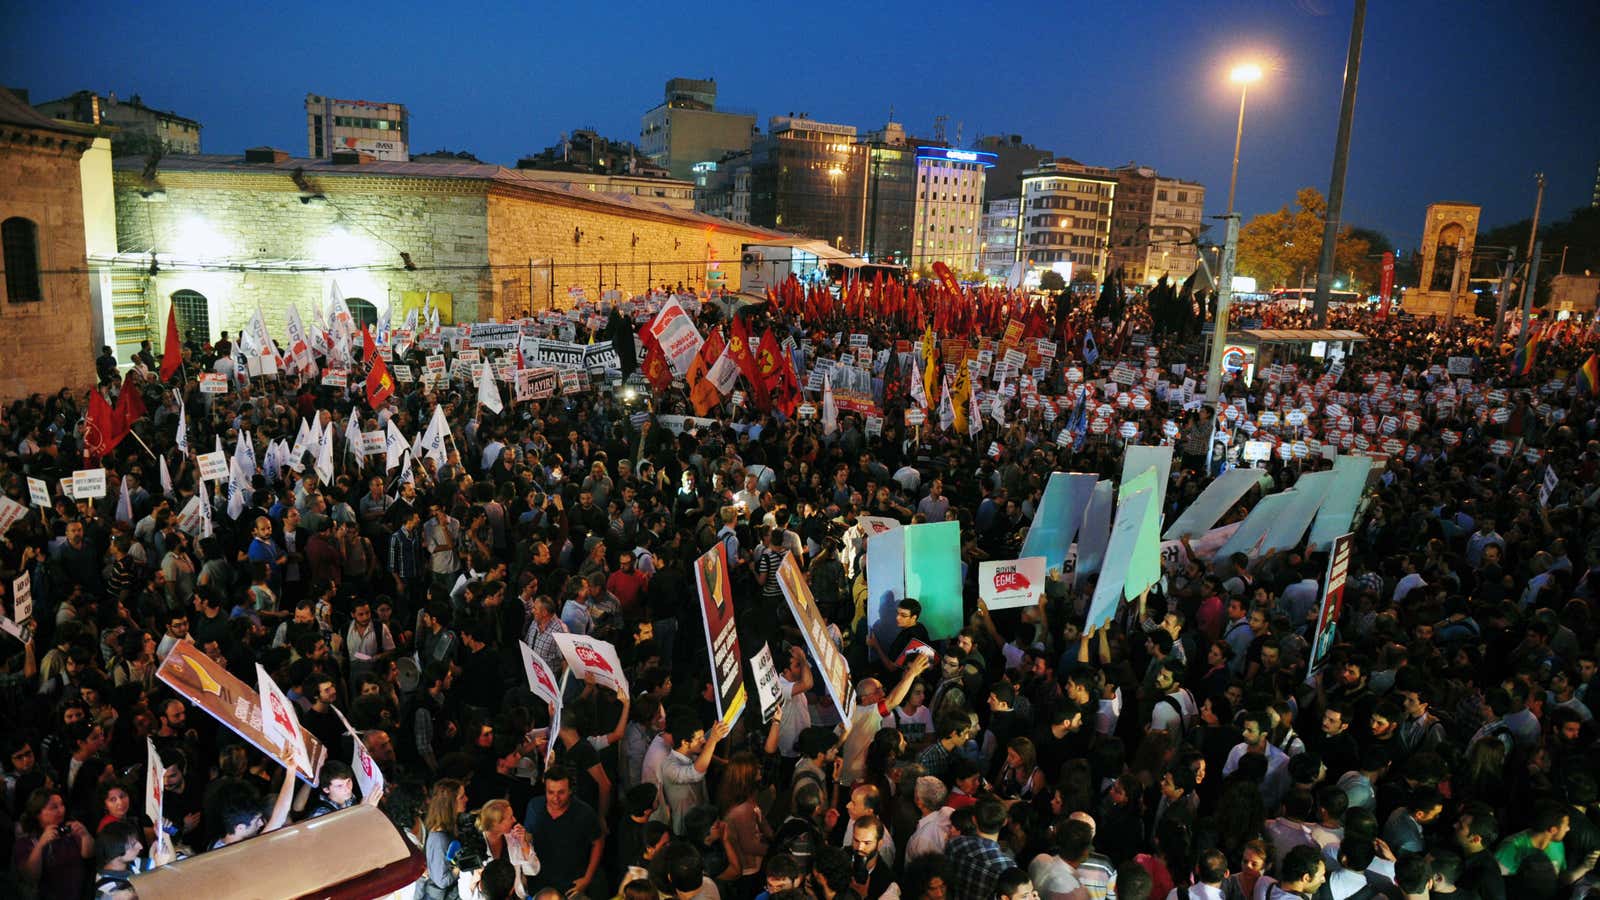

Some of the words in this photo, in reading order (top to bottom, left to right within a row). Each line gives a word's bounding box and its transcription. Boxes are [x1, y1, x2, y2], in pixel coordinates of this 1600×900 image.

[539, 350, 582, 364] HAYIR!
[586, 350, 618, 367] AYIR!
[528, 378, 554, 394] HAYIR!
